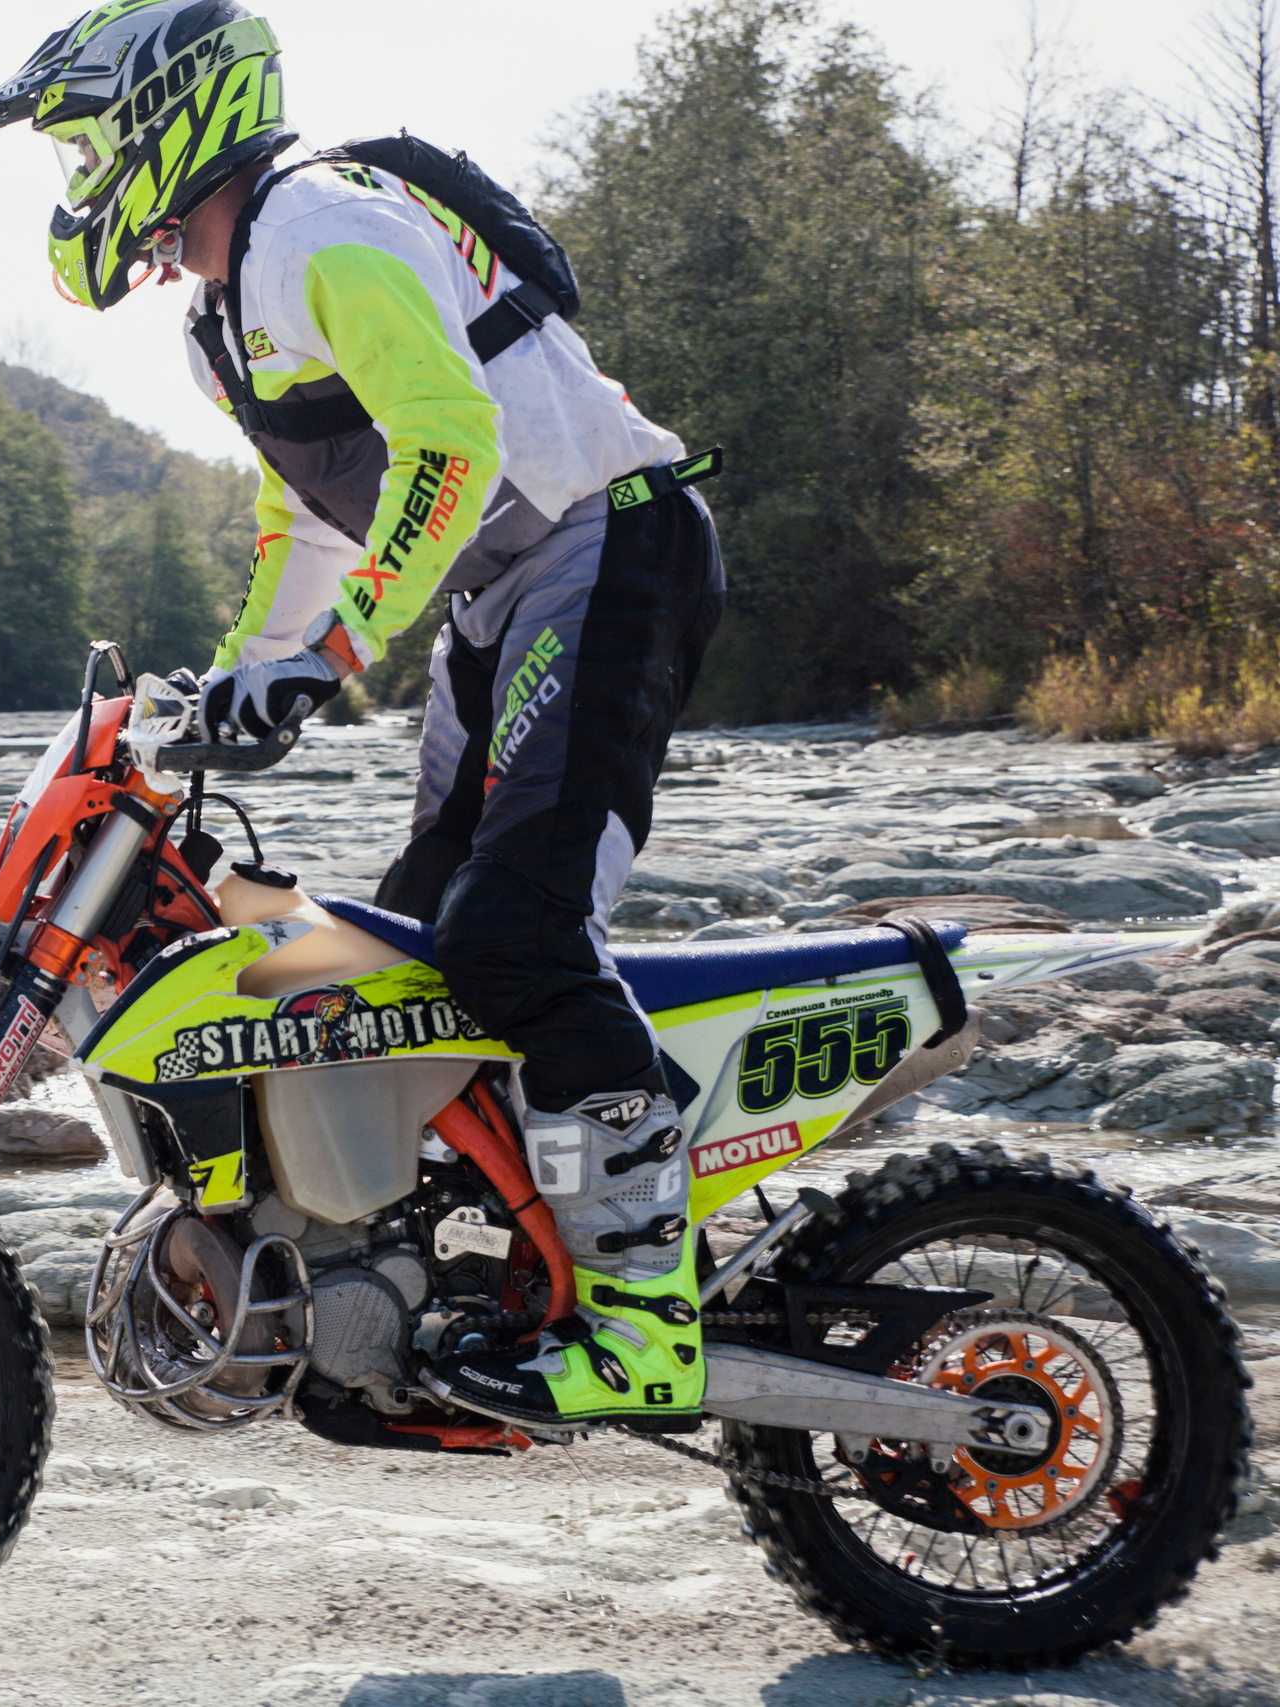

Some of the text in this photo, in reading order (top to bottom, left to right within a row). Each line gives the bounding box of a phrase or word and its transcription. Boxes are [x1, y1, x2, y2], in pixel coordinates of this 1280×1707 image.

[111, 30, 235, 143] 100%
[76, 259, 87, 291] Airoh
[346, 449, 447, 621] EXTREME
[426, 456, 470, 543] MOTO
[200, 1000, 457, 1066] START MOTO
[737, 995, 911, 1115] 555
[698, 1127, 797, 1173] MOTUL
[644, 1382, 673, 1405] G
